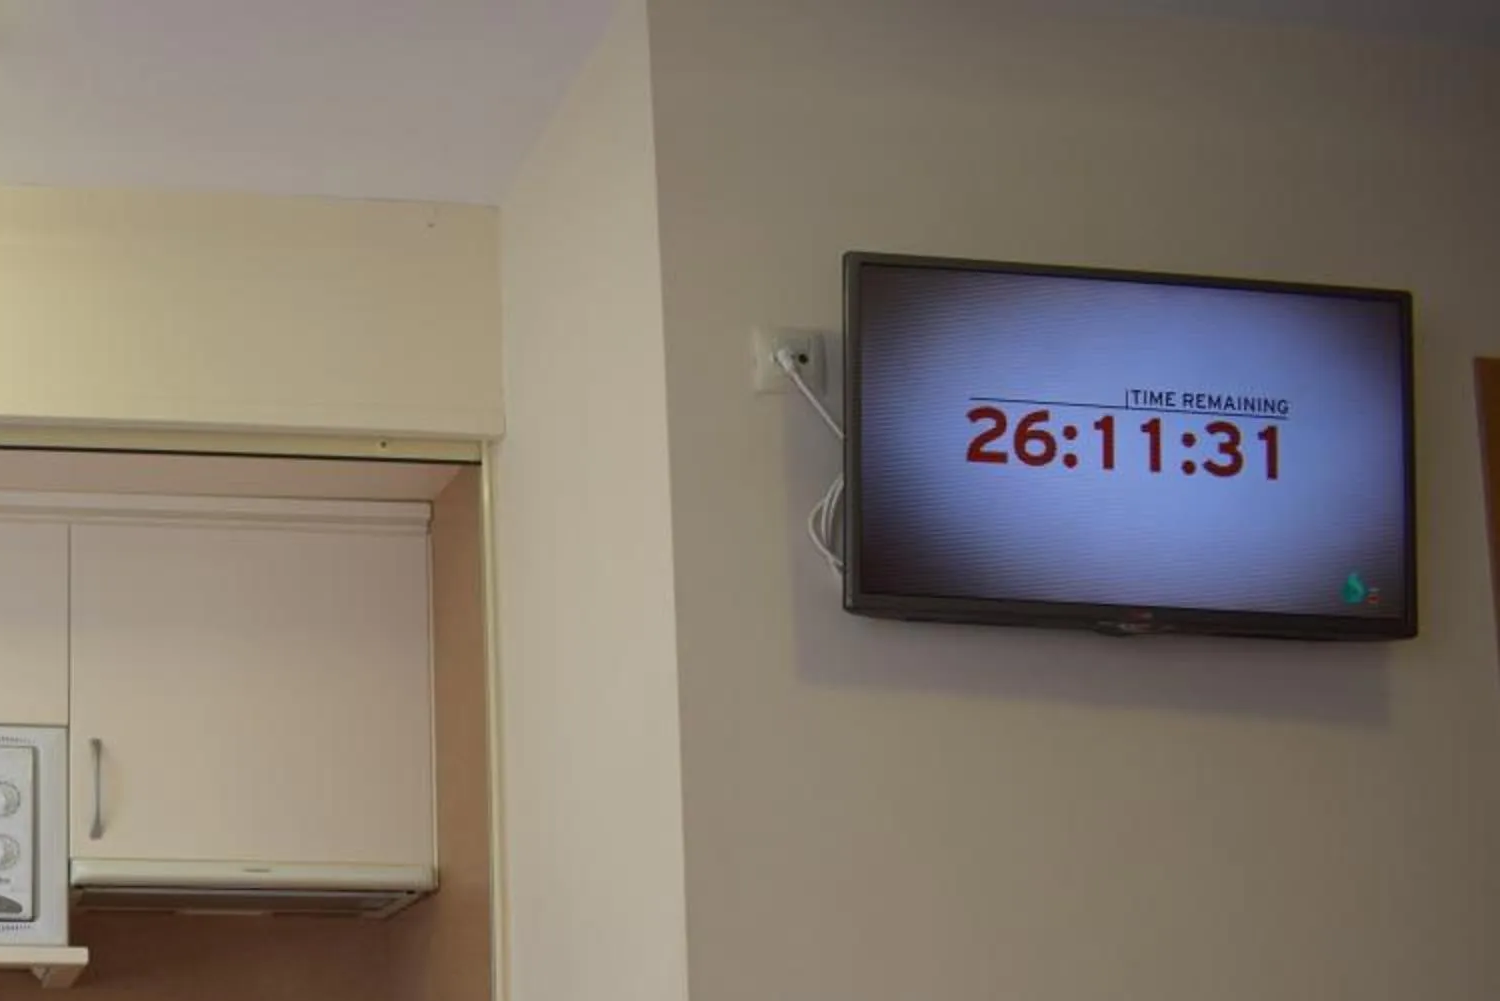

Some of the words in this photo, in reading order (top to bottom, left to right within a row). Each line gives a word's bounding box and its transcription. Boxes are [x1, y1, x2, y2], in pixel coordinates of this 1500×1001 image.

[1131, 389, 1176, 408] TIME
[1182, 392, 1289, 415] REMAINING
[965, 406, 1279, 481] 26:11:31
